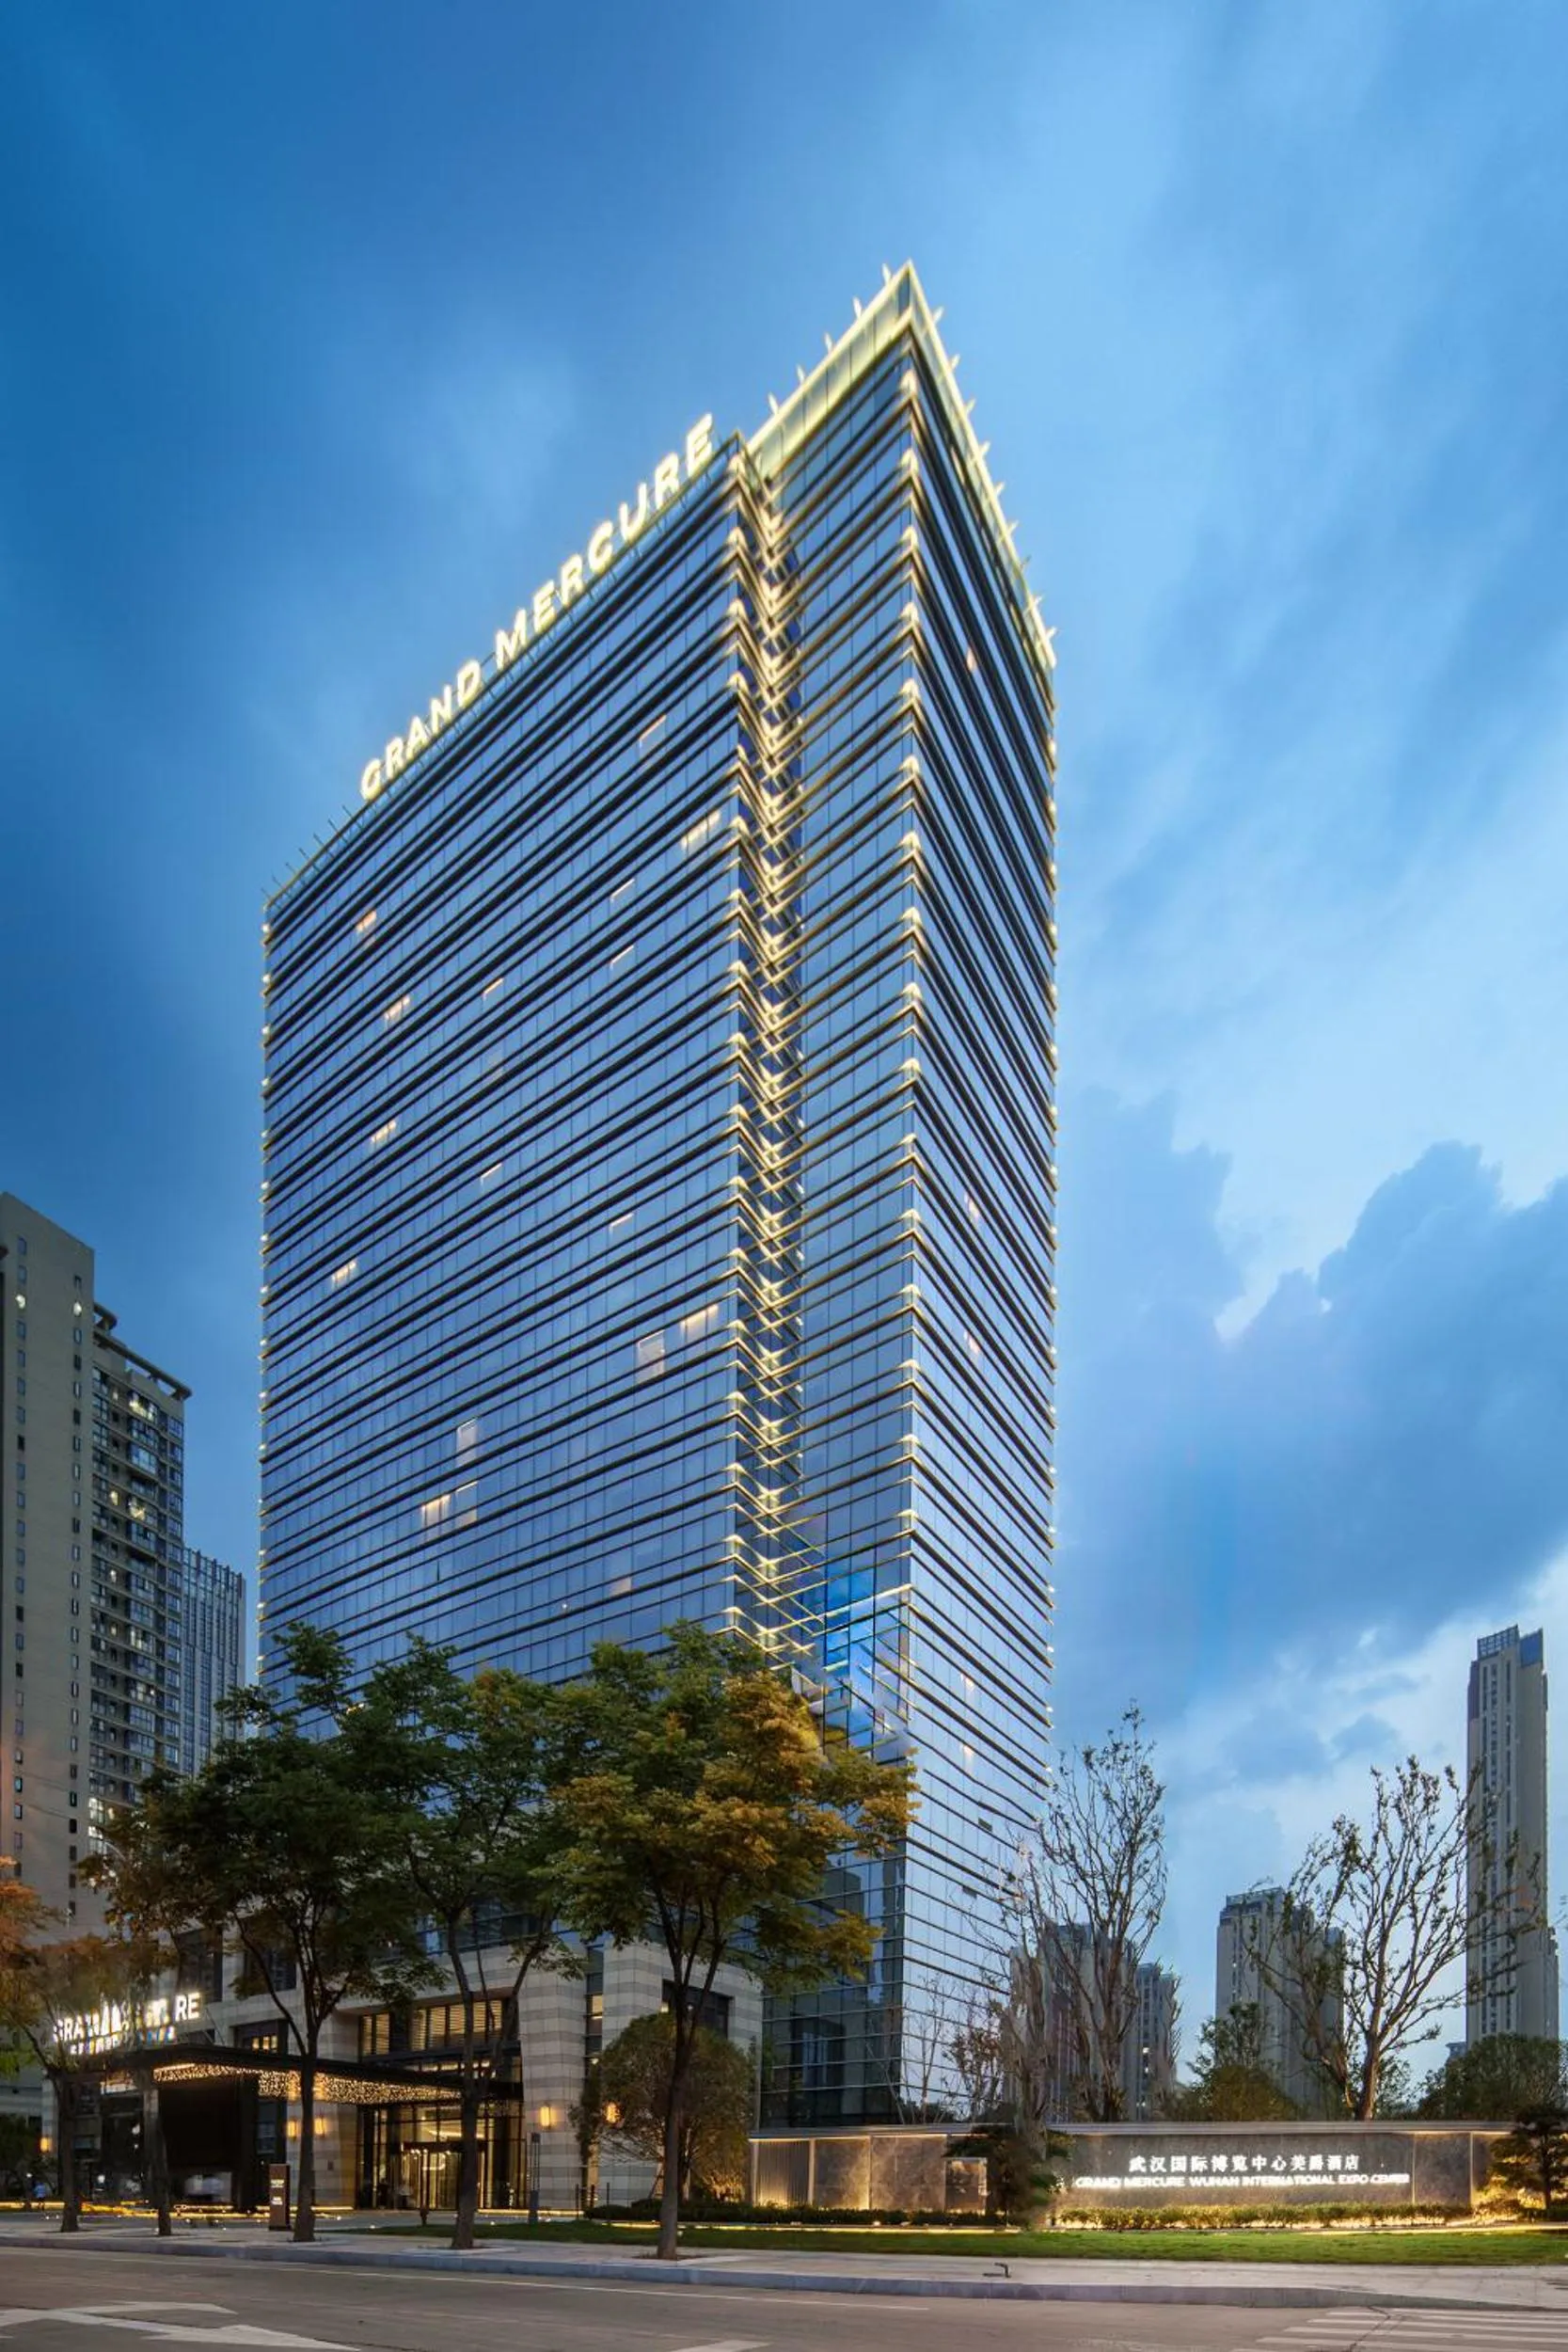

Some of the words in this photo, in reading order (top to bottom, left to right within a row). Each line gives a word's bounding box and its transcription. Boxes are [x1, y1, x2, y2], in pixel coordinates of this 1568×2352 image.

[361, 660, 483, 801] GRAND
[495, 412, 713, 671] MERCURE
[1075, 2176, 1122, 2189] GRAND
[1123, 2176, 1185, 2188] MERCURE
[1188, 2176, 1240, 2187] WUHAN
[1242, 2174, 1336, 2187] INTERNATIONAL
[1338, 2174, 1369, 2185] EXPO
